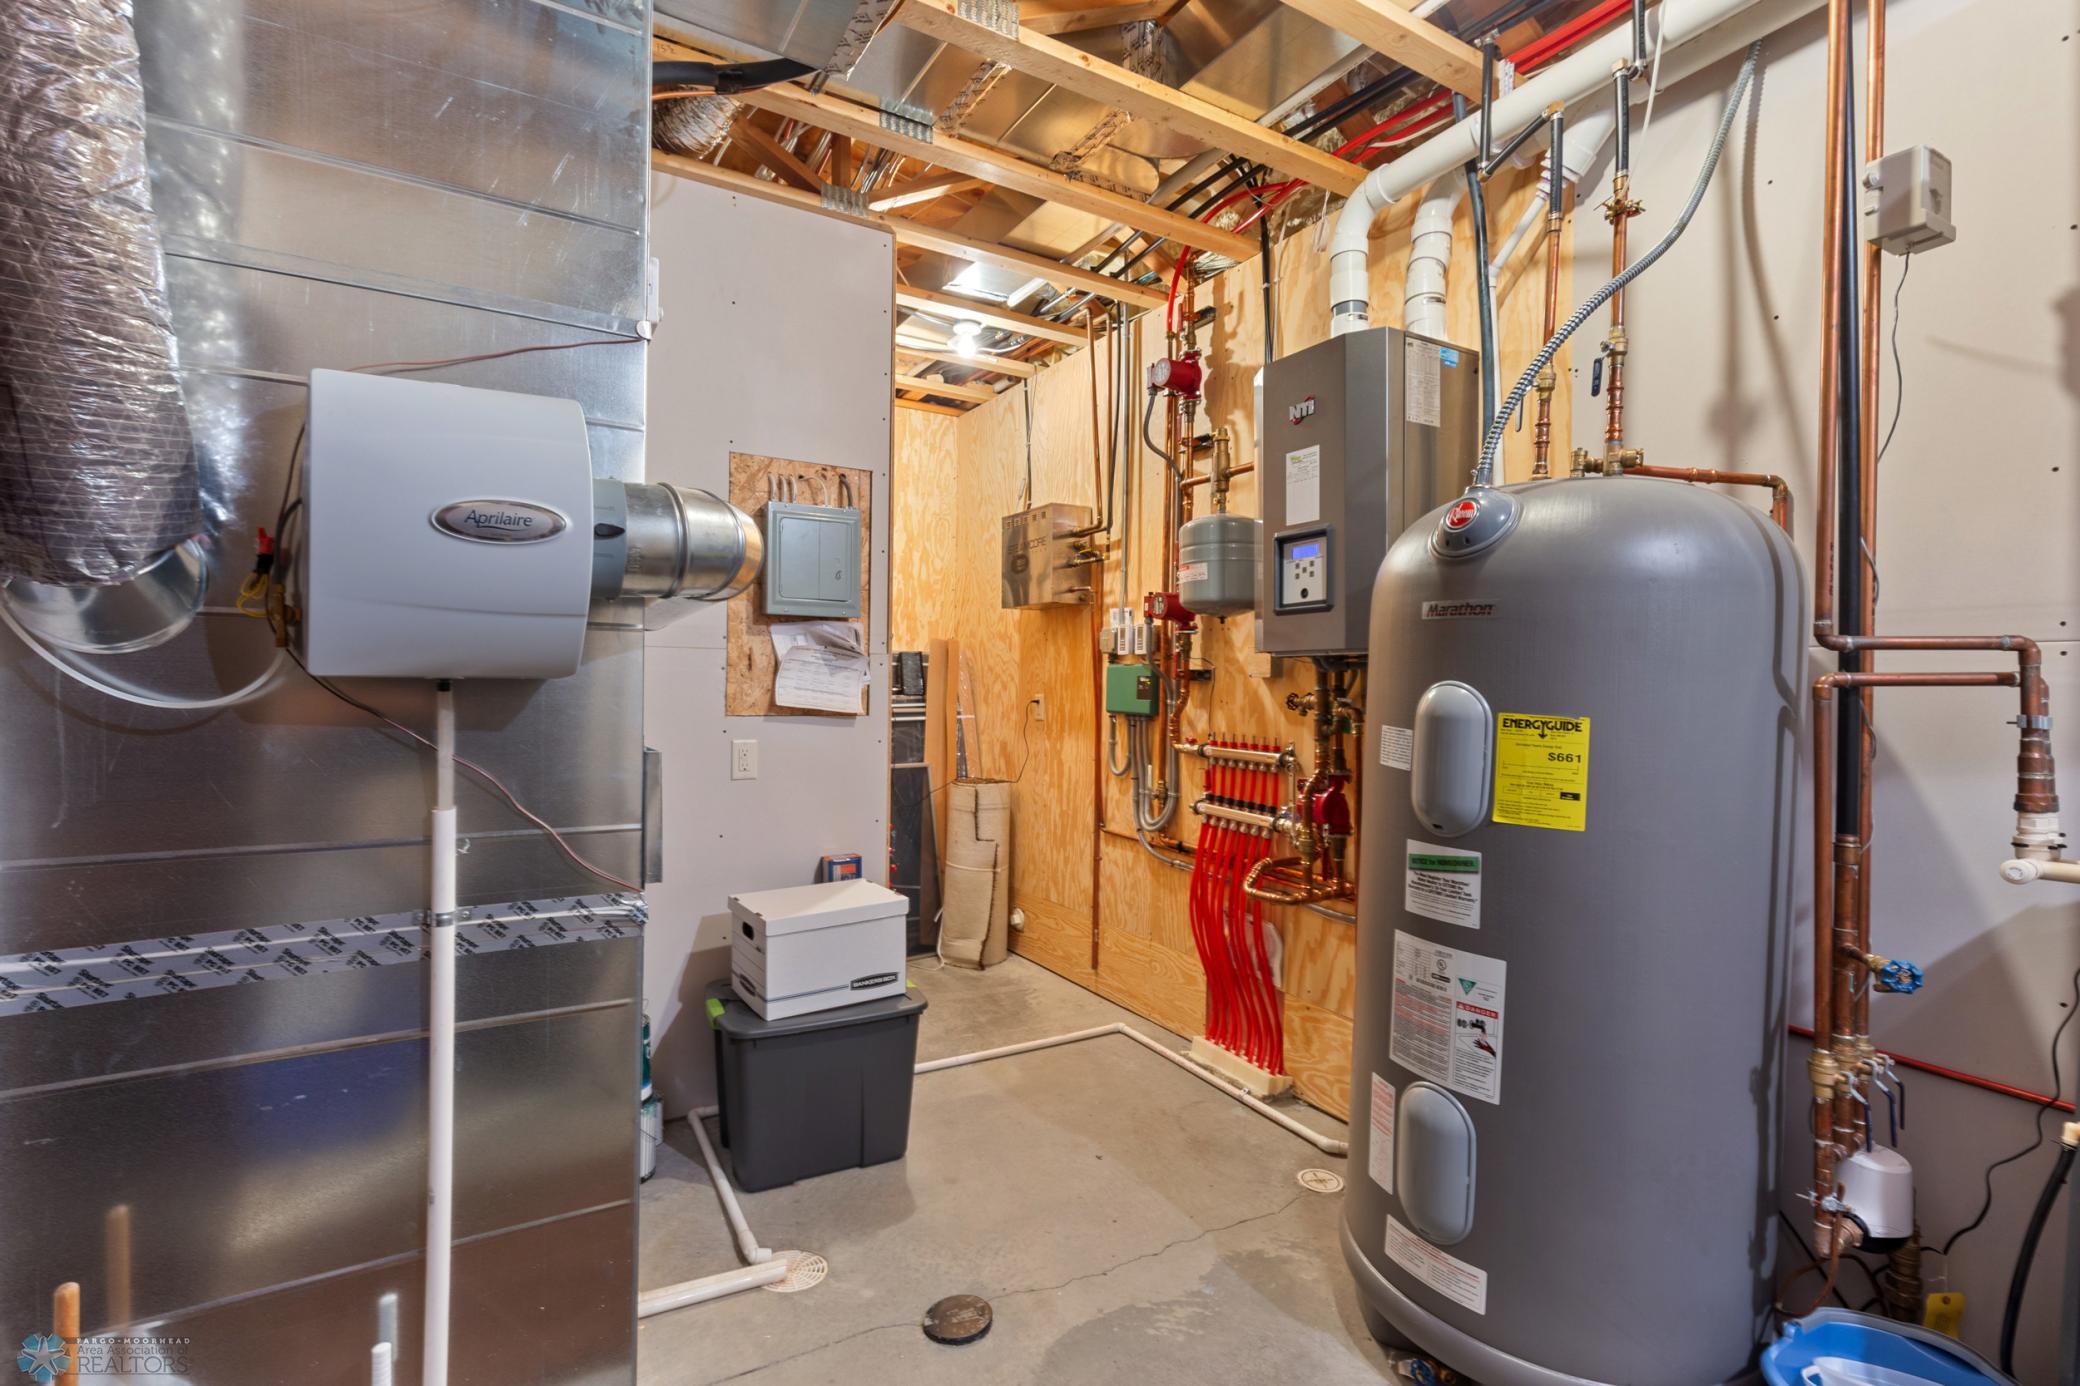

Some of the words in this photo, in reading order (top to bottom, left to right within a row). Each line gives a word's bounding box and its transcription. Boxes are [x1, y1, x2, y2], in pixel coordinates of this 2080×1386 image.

[464, 509, 533, 528] Aprilaire
[1427, 602, 1495, 617] Marathon
[1503, 718, 1583, 733] ENERGYGUIDE
